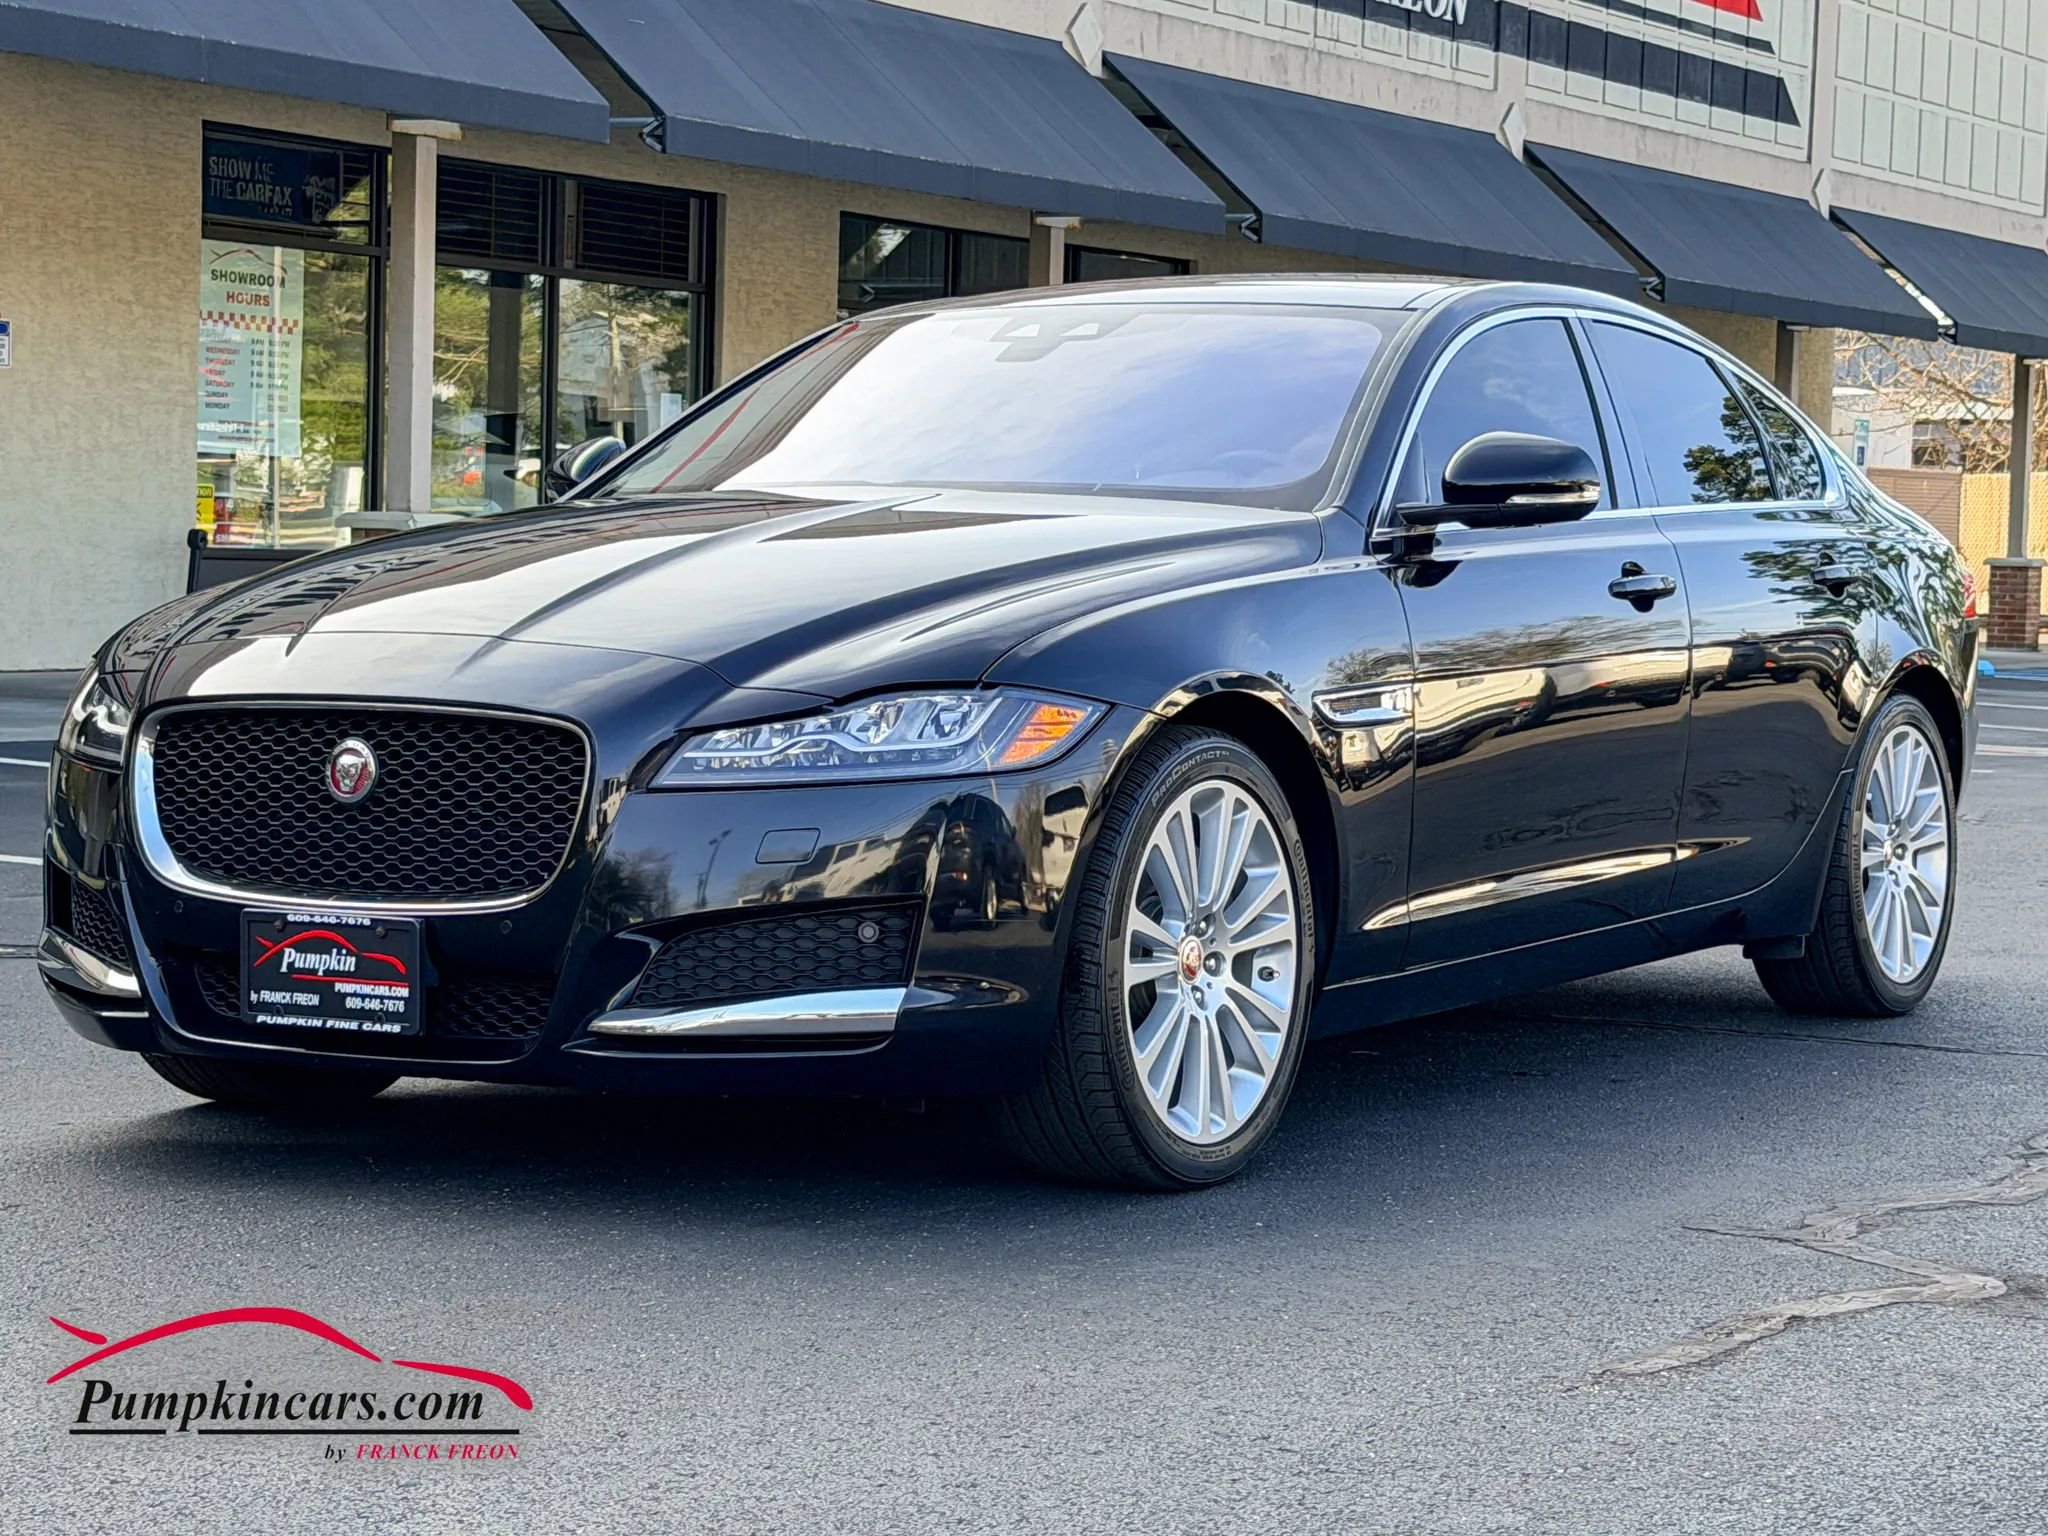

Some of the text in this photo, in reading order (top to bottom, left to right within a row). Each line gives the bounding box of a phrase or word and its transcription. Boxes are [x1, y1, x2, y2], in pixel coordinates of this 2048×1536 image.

[209, 156, 252, 179] SHOW
[208, 177, 293, 206] THE CARFAX
[211, 268, 286, 288] SHOWROOM
[226, 291, 270, 307] HOURS
[287, 914, 371, 926] 609-646-7676
[280, 947, 356, 976] Pumpkin
[250, 990, 320, 1006] by FRANCK FREON
[335, 982, 409, 998] PUMPKINCARS.COM
[345, 997, 405, 1013] 609-646-7676
[256, 1015, 402, 1034] PUMPKIN FINE CARS
